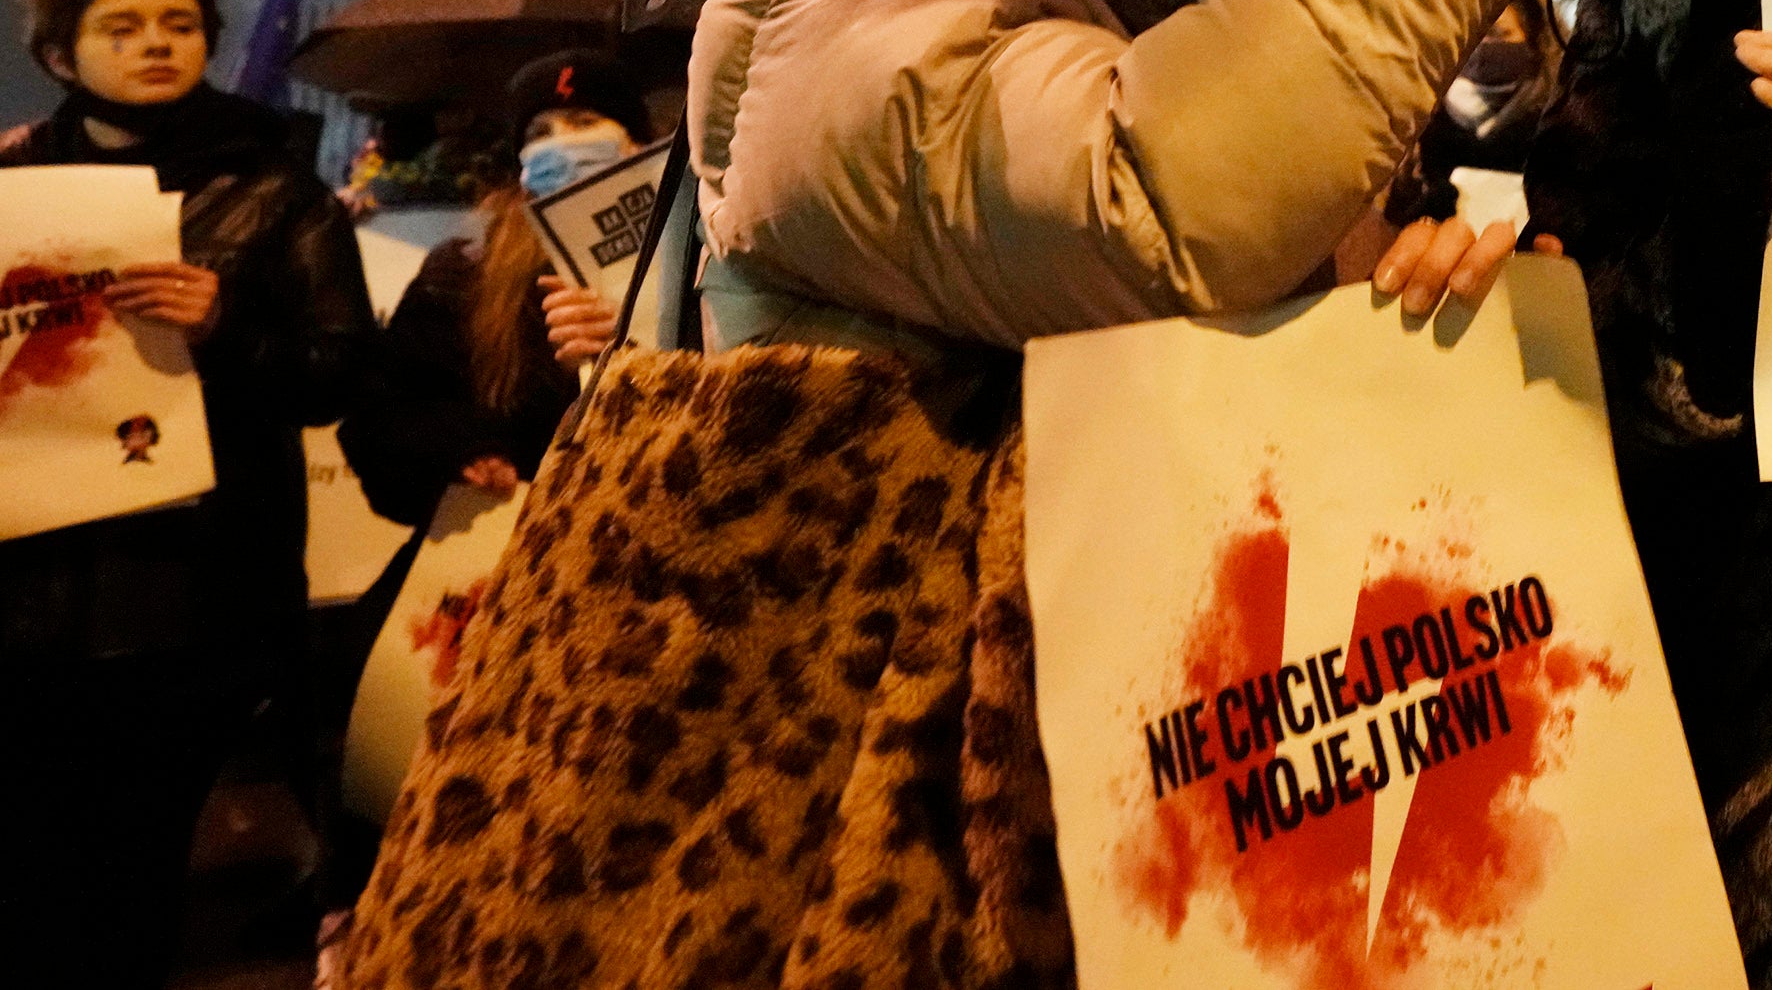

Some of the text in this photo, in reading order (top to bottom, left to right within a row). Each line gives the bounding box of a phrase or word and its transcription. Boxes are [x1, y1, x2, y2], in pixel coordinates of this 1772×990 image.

[1144, 575, 1554, 800] NIE CHCIEJ POLSKO
[1223, 670, 1512, 853] MOJEJ KRWI
